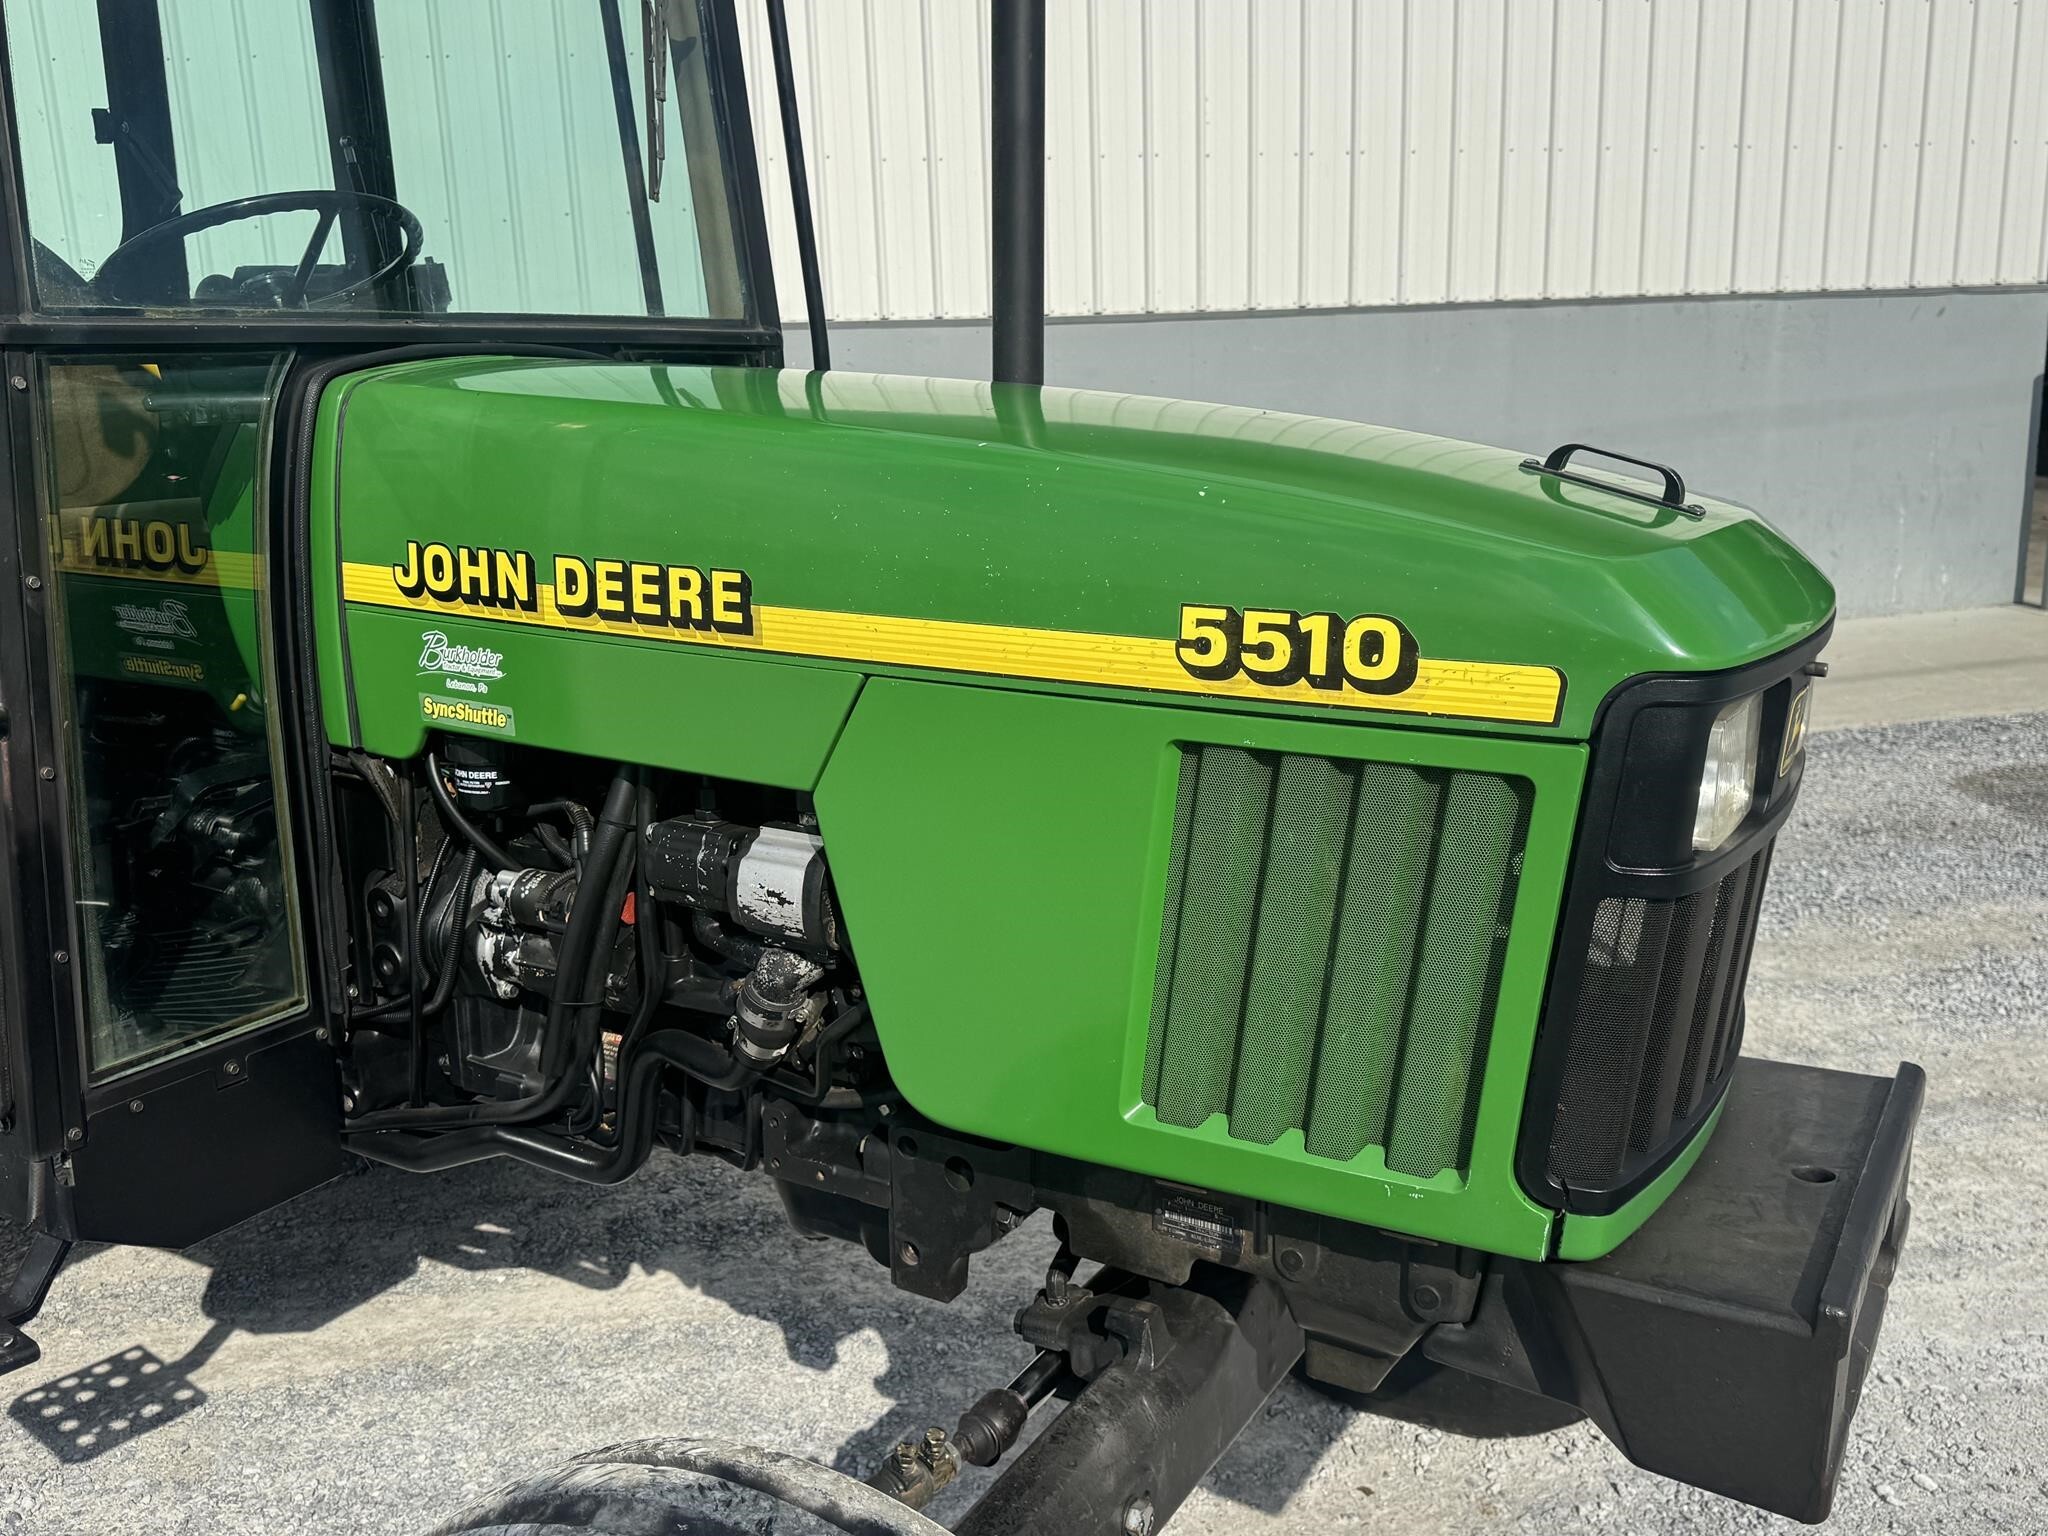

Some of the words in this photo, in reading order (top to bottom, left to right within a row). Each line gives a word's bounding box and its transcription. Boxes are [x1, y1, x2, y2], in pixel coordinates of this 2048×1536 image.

[393, 540, 536, 612] JOHN
[553, 553, 754, 636] DEERE
[419, 630, 503, 670] Burkholder
[1175, 603, 1421, 695] 5510
[455, 768, 467, 778] OHN
[468, 771, 498, 779] DEERE
